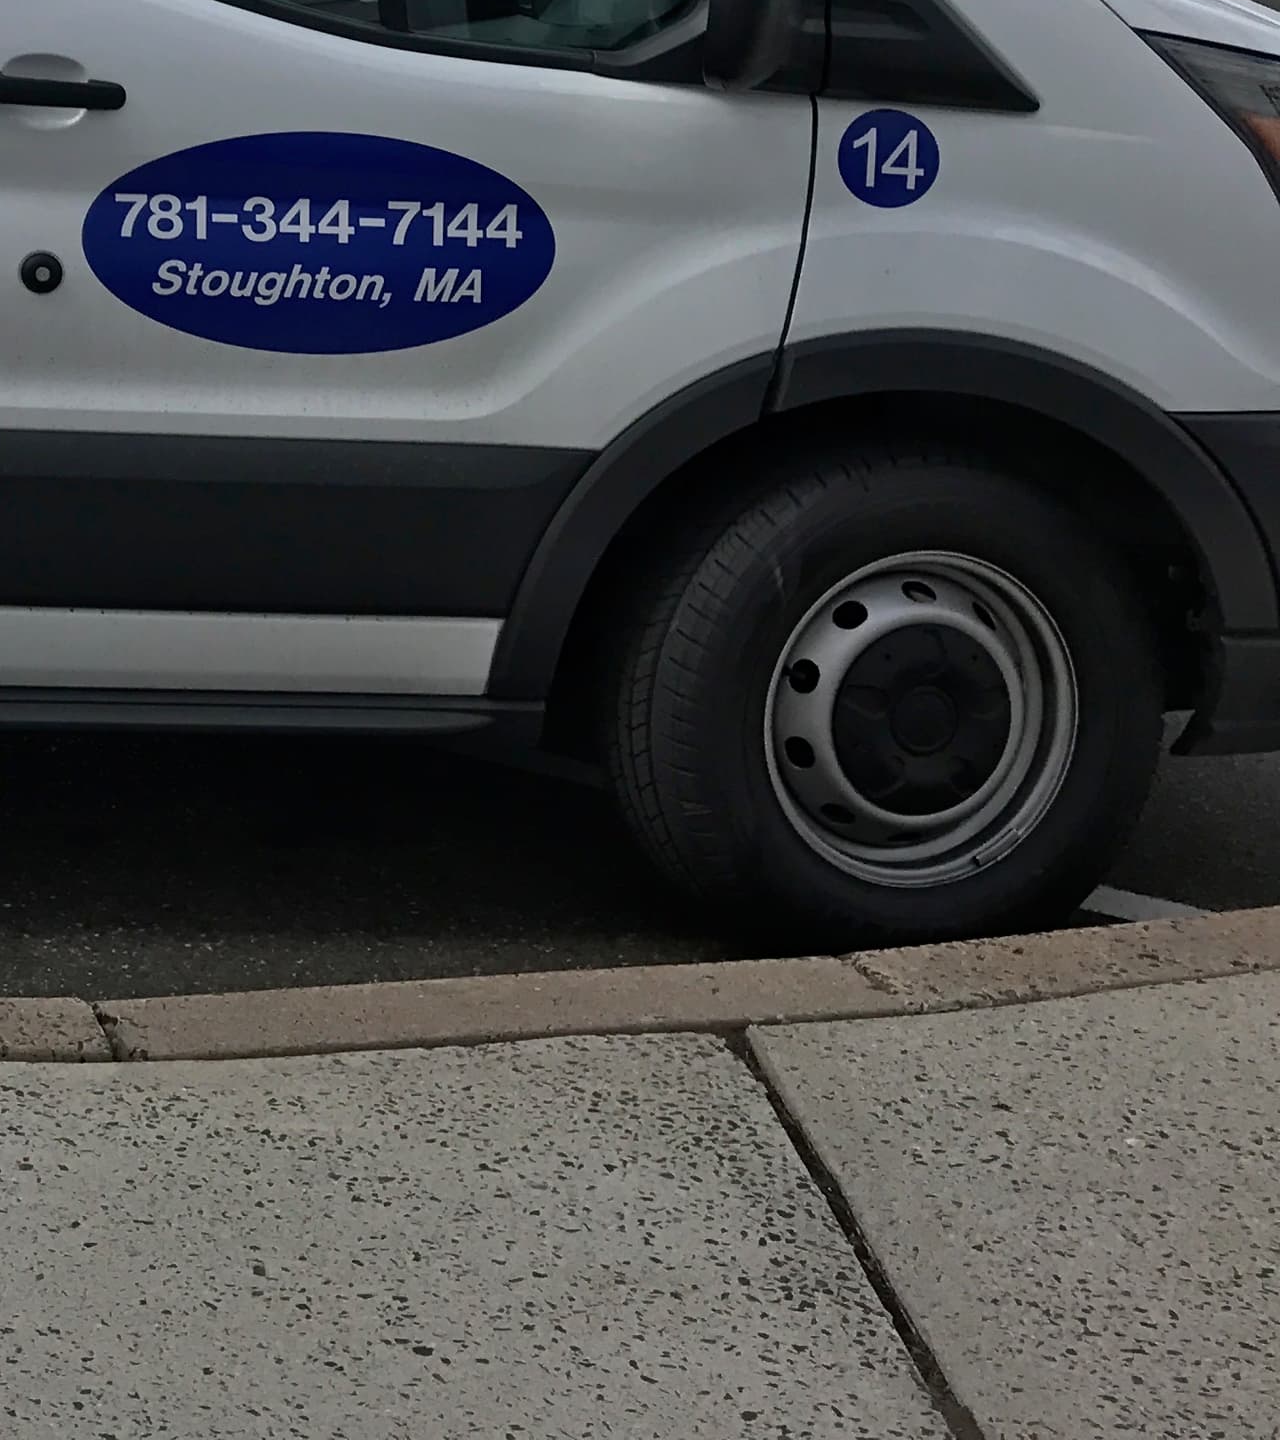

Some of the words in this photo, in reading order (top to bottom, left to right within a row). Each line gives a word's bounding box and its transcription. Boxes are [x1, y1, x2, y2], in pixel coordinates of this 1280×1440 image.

[851, 127, 925, 192] 14
[114, 192, 524, 250] 781-344-7144
[151, 258, 394, 308] Stoughton,
[412, 266, 484, 305] MA
